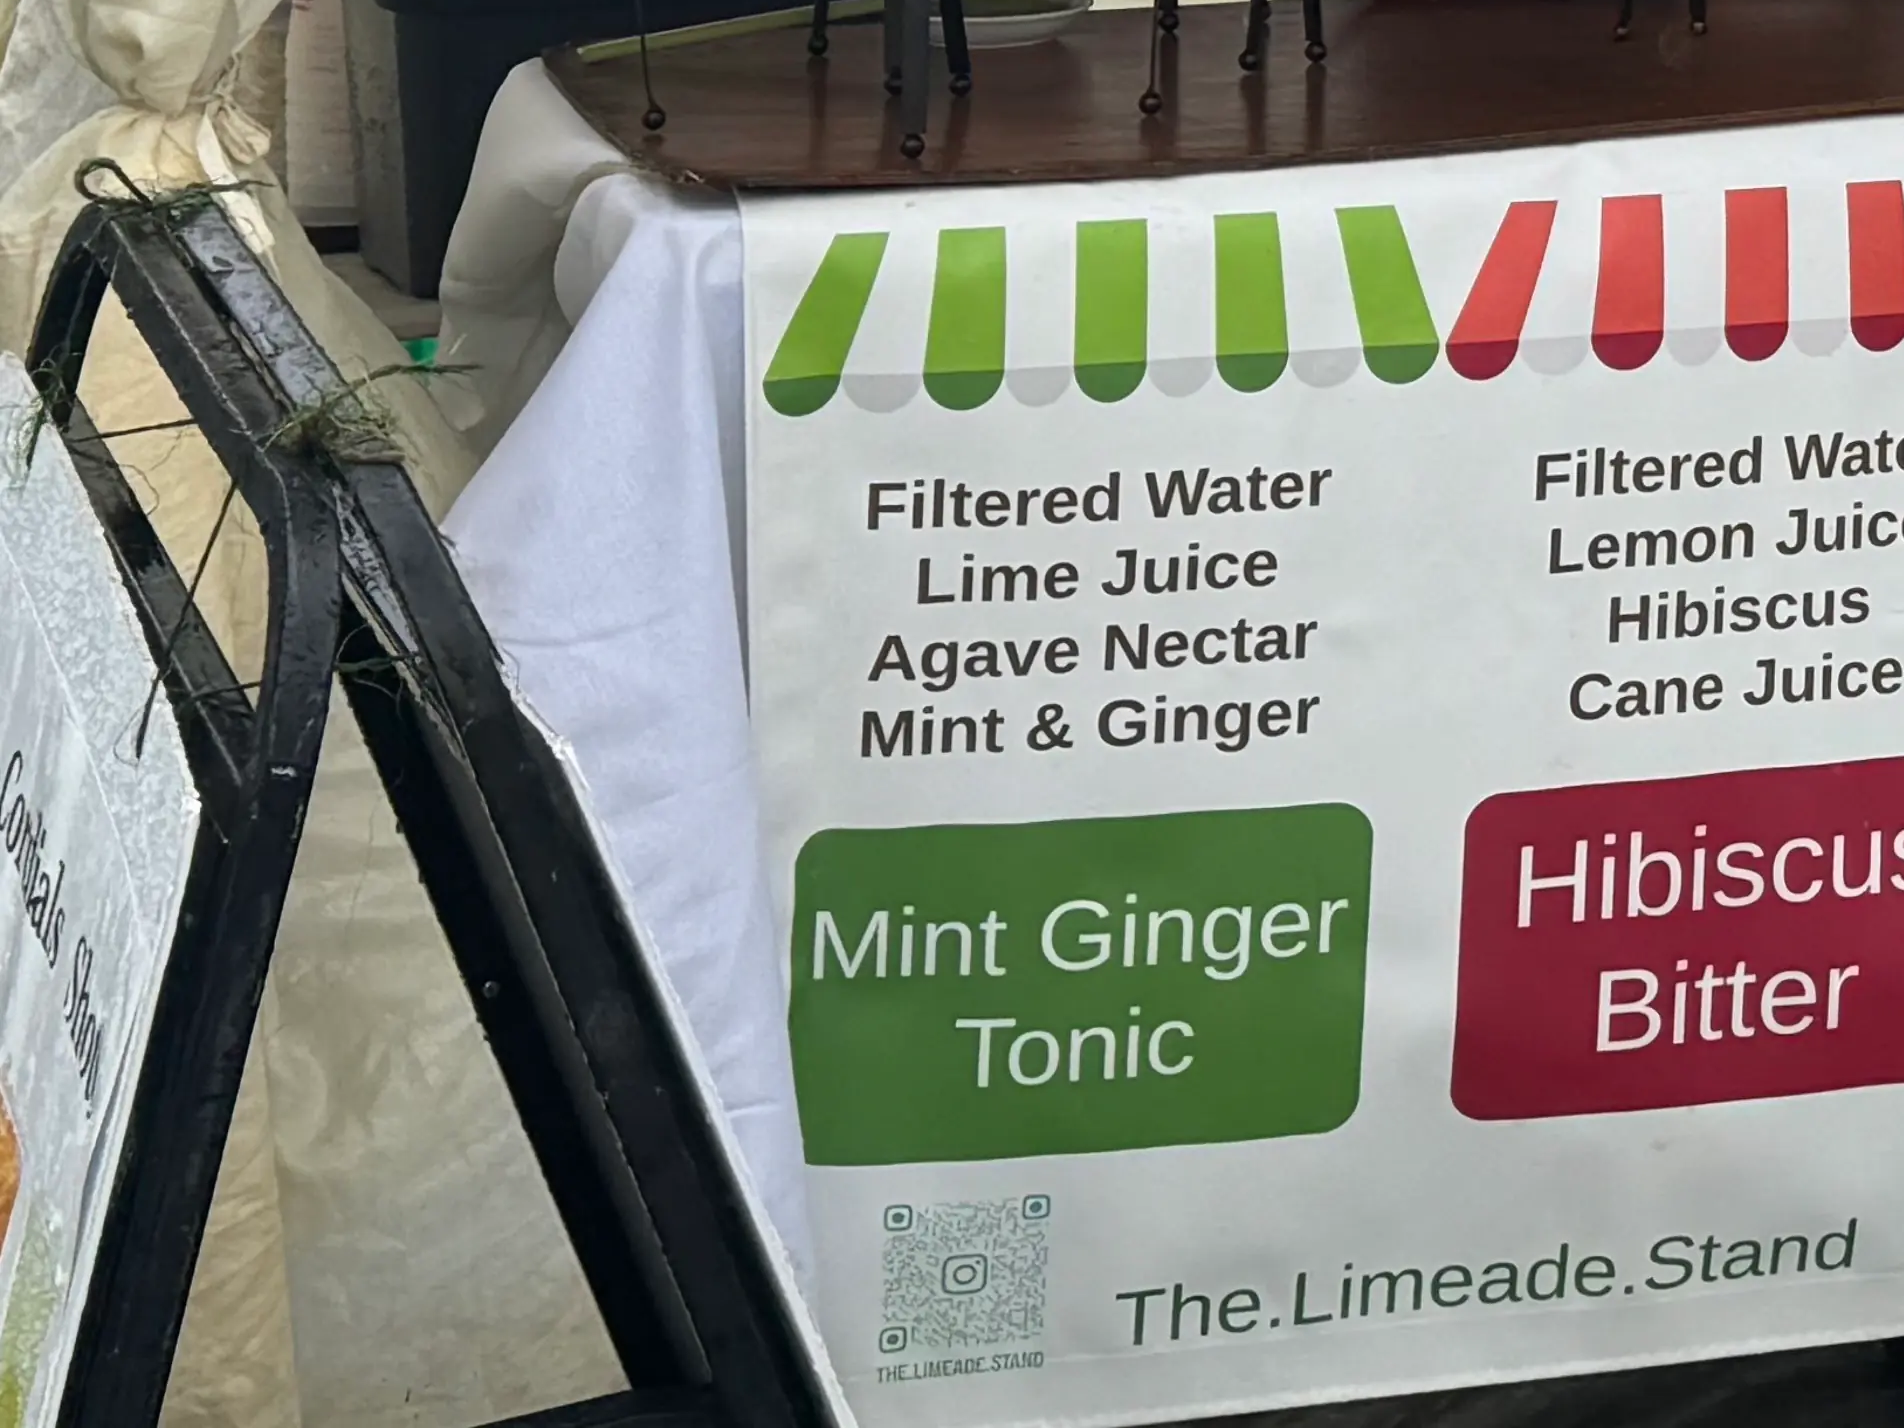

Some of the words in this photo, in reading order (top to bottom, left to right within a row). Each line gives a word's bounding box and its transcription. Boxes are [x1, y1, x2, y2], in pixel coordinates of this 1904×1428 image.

[868, 472, 1120, 530] Filtered
[1145, 467, 1332, 518] Water
[918, 554, 1078, 604] Lime
[1102, 543, 1277, 595] Juice
[868, 635, 1079, 692] Agave
[1105, 619, 1317, 670] Nectar
[861, 706, 1004, 757] Mint
[1027, 704, 1073, 751] &
[1098, 695, 1320, 752] Ginger
[813, 906, 1007, 979] Mint
[1042, 894, 1348, 980] Ginger
[1597, 960, 1859, 1051] Bitter
[956, 1006, 1194, 1087] Tonic
[1116, 1218, 1857, 1345] The.Limeade.Stand
